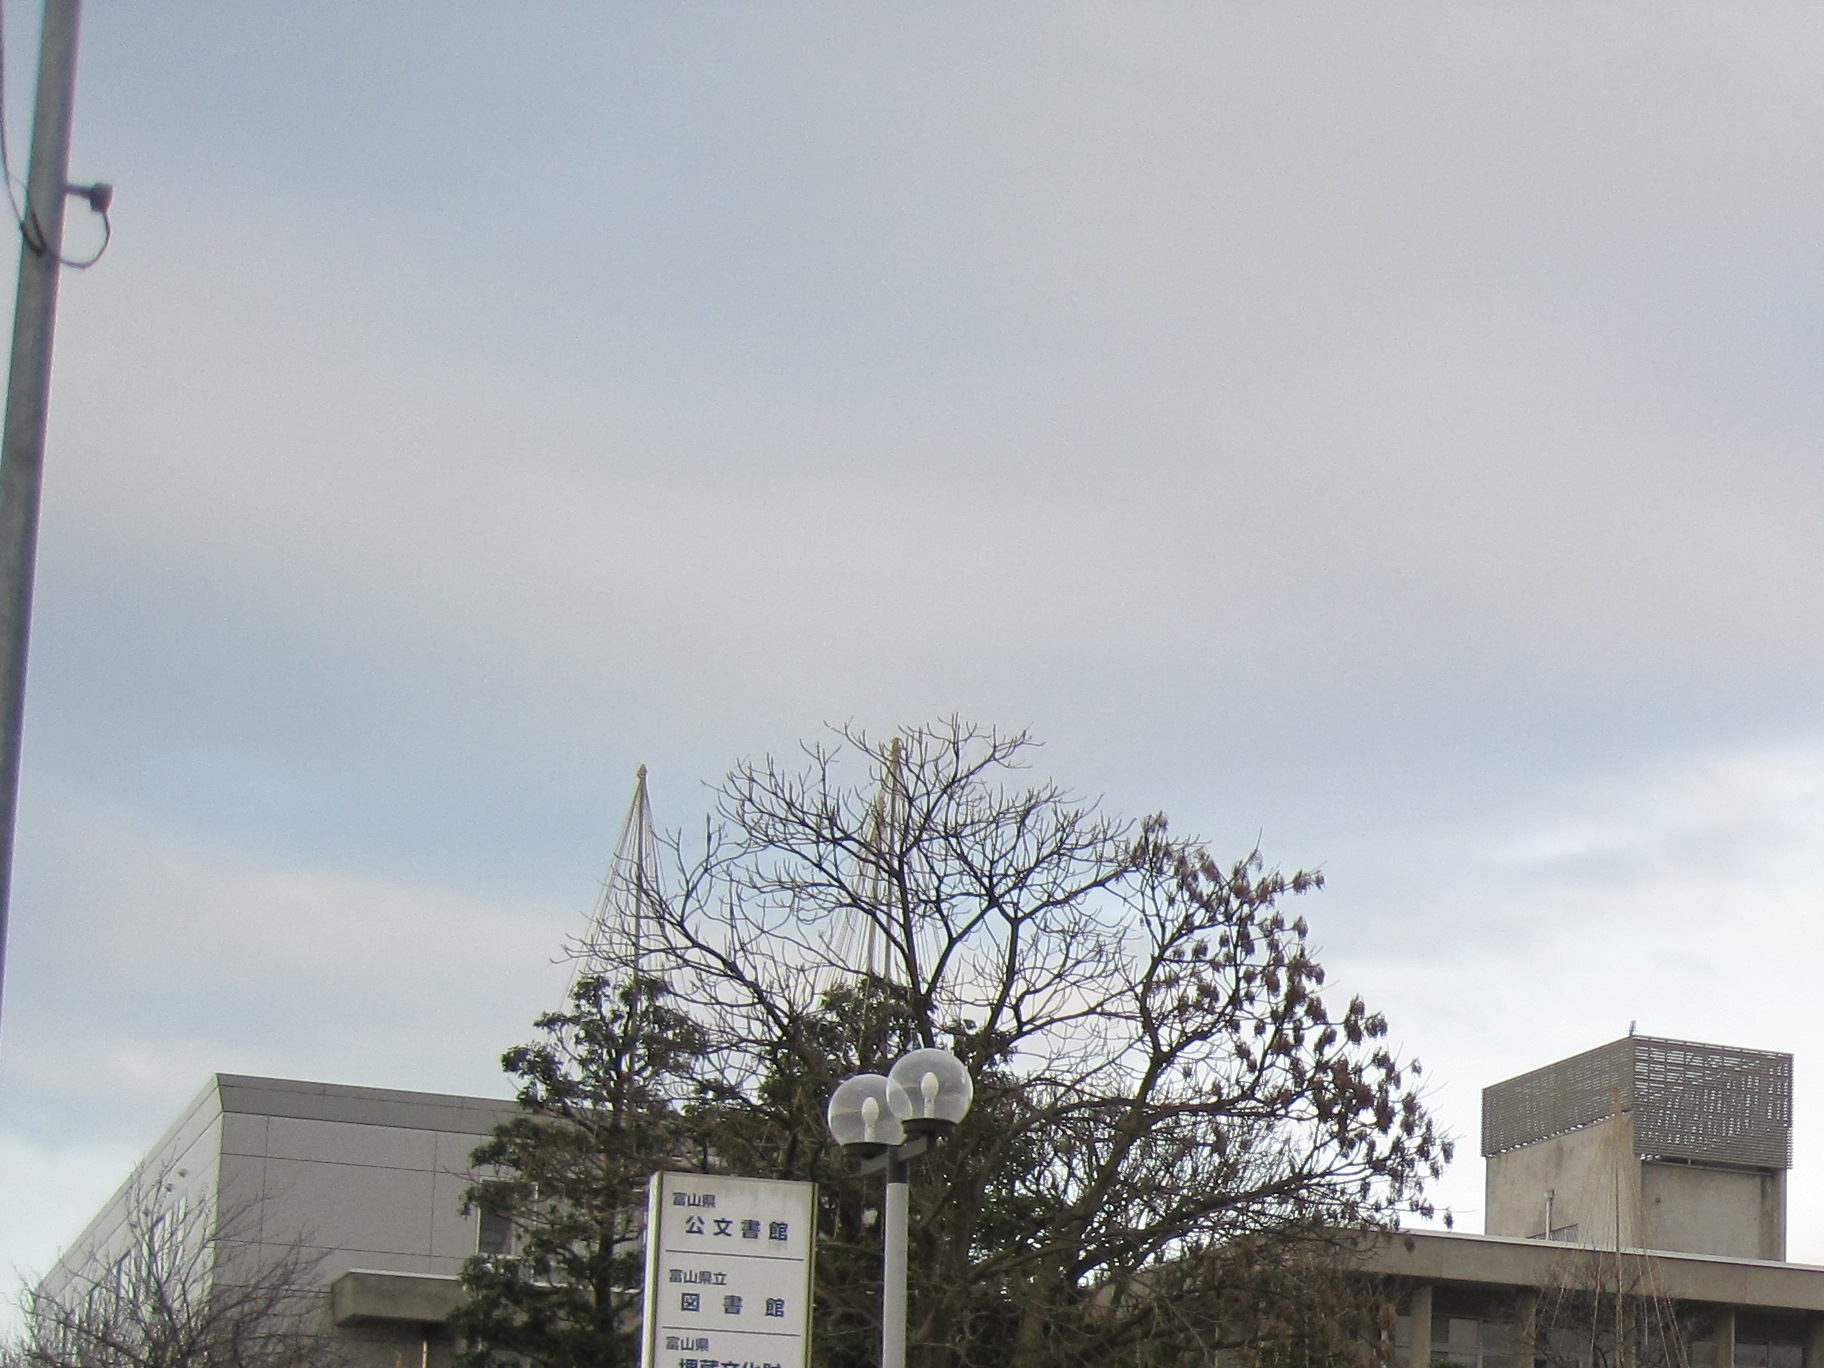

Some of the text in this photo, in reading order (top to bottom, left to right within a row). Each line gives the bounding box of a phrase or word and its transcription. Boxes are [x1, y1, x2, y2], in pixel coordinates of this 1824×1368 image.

[672, 1192, 716, 1208] 富山県
[685, 1215, 788, 1242] 公文書館
[669, 1268, 727, 1285] 富山県立
[681, 1292, 785, 1318] 図書館
[665, 1336, 709, 1352] 富山県
